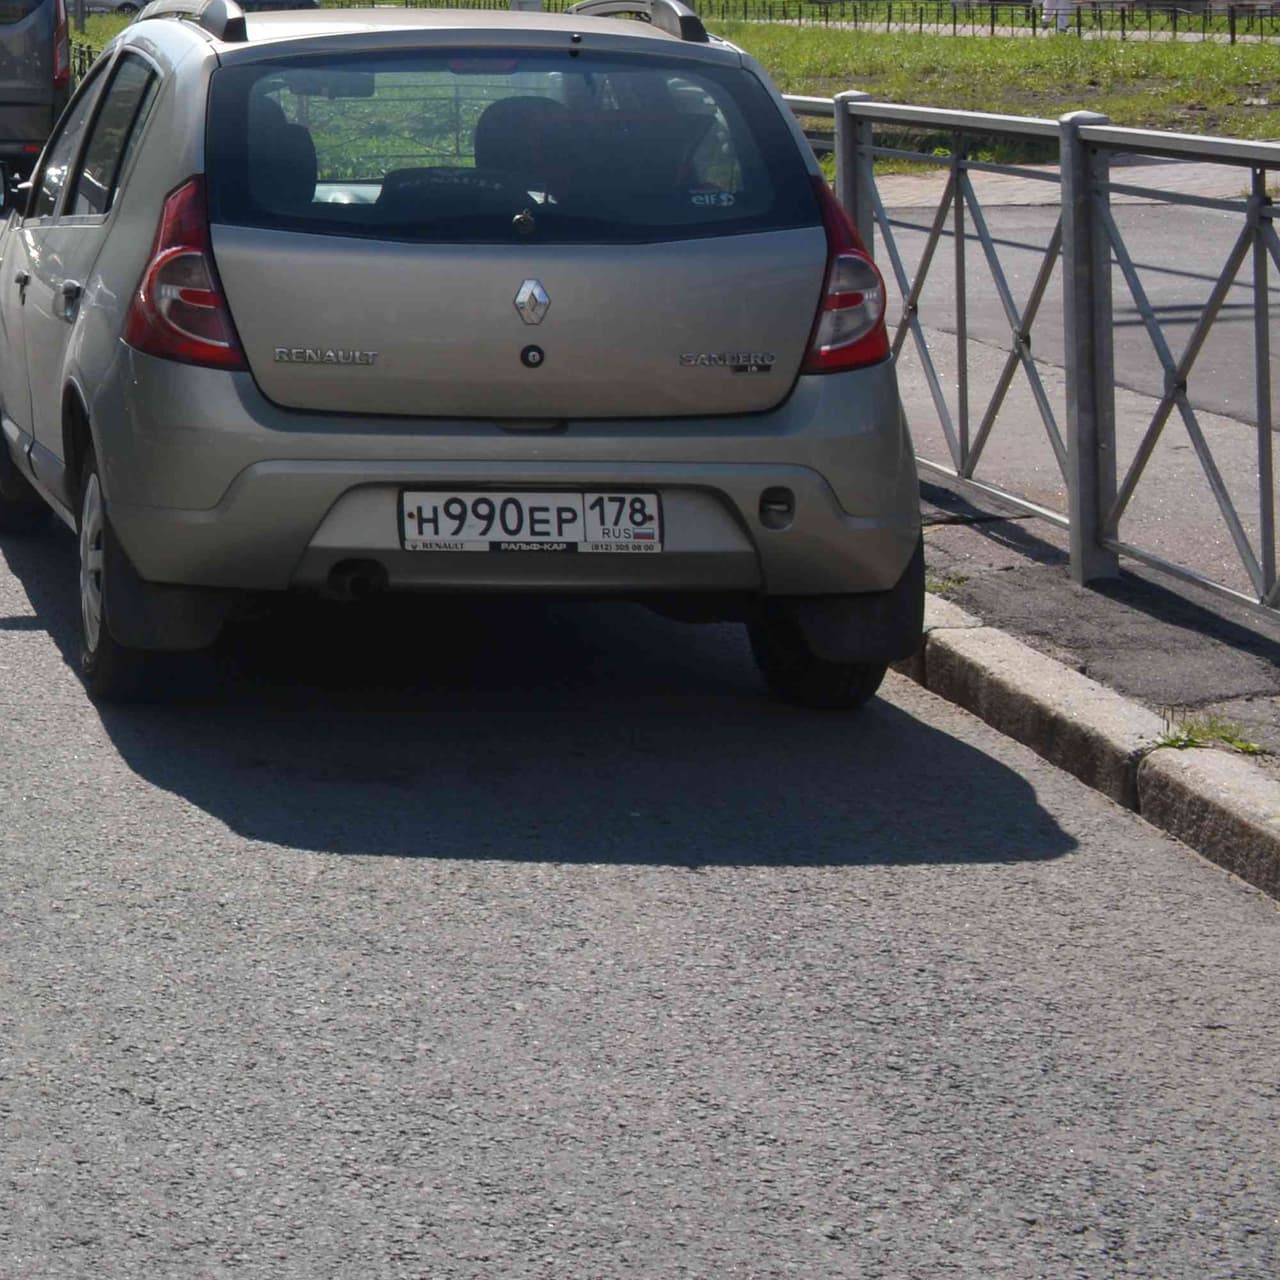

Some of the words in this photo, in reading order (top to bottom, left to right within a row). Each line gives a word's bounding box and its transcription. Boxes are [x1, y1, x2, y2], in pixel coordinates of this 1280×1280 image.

[691, 193, 718, 206] elf
[274, 346, 379, 366] RENAULT
[680, 351, 777, 367] SANDERO
[416, 497, 578, 536] Н990ЕР
[589, 496, 648, 527] 178
[602, 528, 632, 539] RUS
[422, 542, 465, 551] RENAULT
